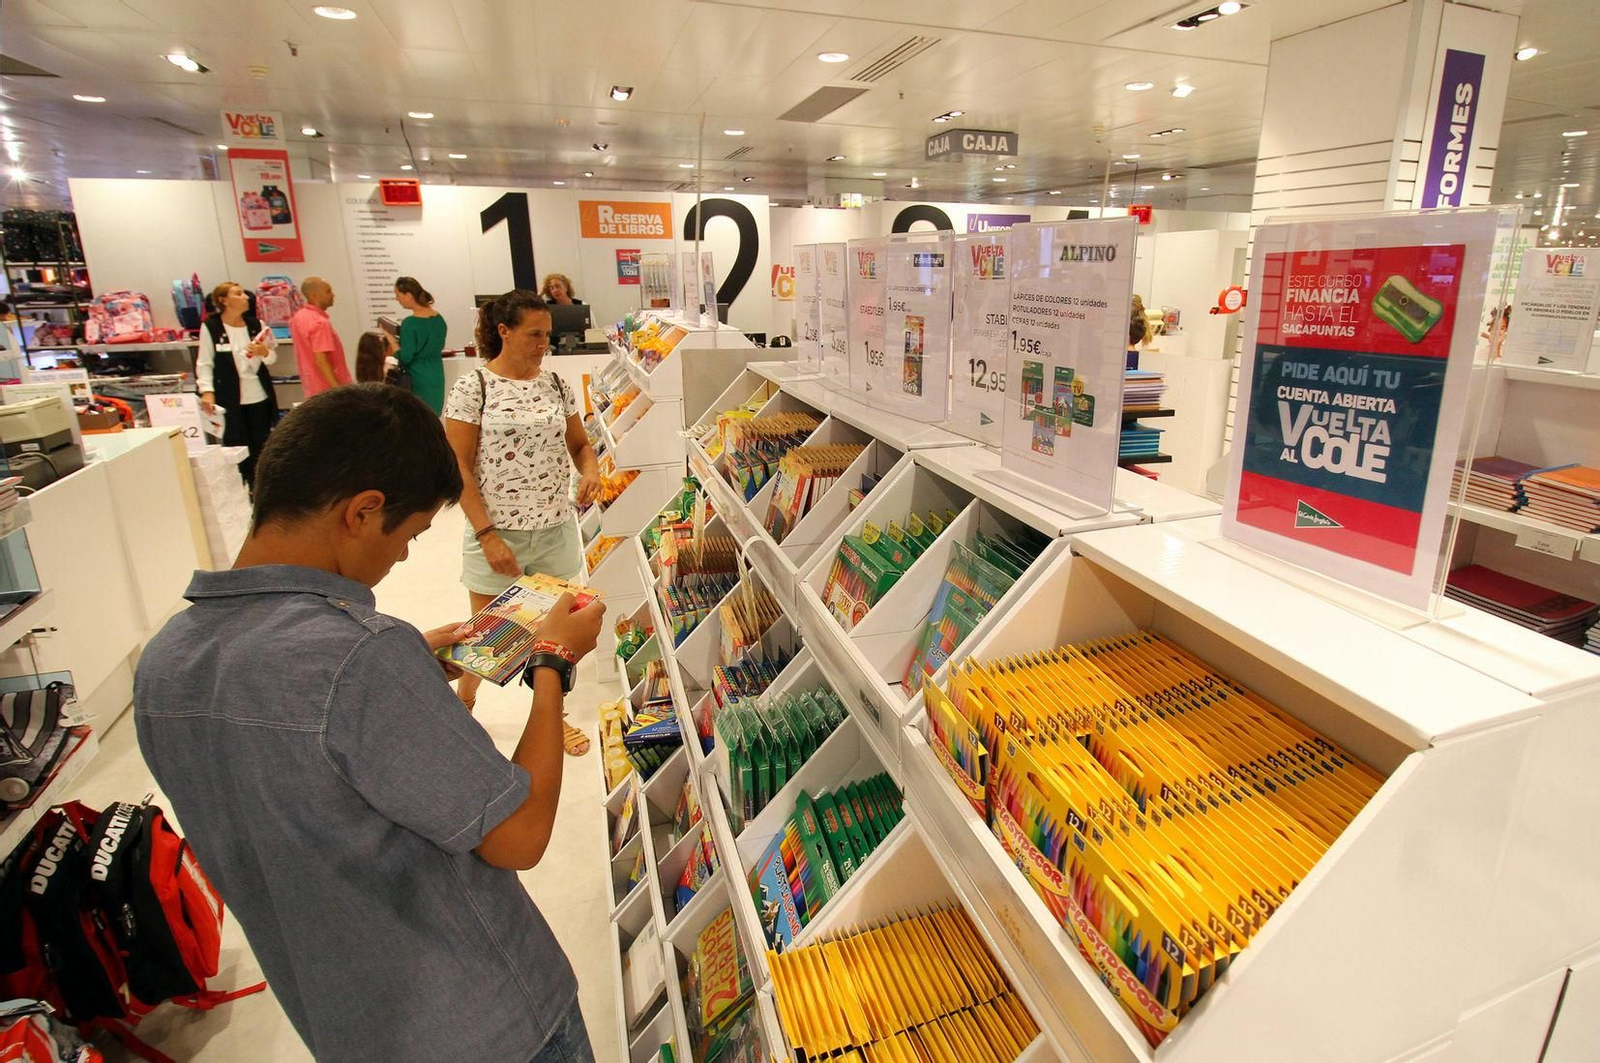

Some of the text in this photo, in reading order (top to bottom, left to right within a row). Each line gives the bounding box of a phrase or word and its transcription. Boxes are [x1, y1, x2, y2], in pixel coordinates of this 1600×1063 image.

[225, 112, 275, 129] VUELTA
[240, 121, 276, 139] COLE
[928, 133, 1009, 156] CAJA CAJA
[1436, 82, 1473, 208] FORMES
[597, 205, 663, 225] RESERVA
[600, 224, 664, 235] DE LIBROS
[480, 192, 538, 293] 1
[684, 198, 759, 309] 2
[1060, 244, 1117, 262] ALPINO
[971, 244, 1005, 268] VUELTA
[979, 254, 1005, 277] COLE
[1545, 253, 1585, 268] VUELTA
[1287, 274, 1362, 288] ESTE CURSO
[1036, 294, 1044, 302] DE
[1044, 295, 1072, 305] COLORES
[1073, 297, 1079, 305] 12
[1080, 298, 1108, 308] unidades
[1285, 288, 1360, 304] FINANCIA
[985, 313, 1008, 326] STABI
[1012, 305, 1086, 320] ROTULADORES 12 unidades
[1012, 317, 1060, 330] CERAS 12 unidades
[1283, 305, 1359, 323] HASTA EL
[1282, 323, 1356, 338] SACAPUNTAS
[969, 358, 1007, 393] 12,95
[1281, 361, 1401, 390] PIDE AQUÍ TU
[1277, 385, 1397, 414] CUENTA ABIERTA
[1277, 400, 1392, 447] VUELTA
[1280, 425, 1391, 484] AL COLE
[996, 715, 1003, 730] 12
[1011, 714, 1019, 729] 12
[969, 731, 977, 747] 12
[1069, 812, 1080, 827] 12
[1101, 802, 1112, 820] 12
[31, 819, 77, 895] DUCATI
[91, 813, 129, 882] DUCATI
[1230, 909, 1245, 933] 12
[1240, 900, 1255, 924] 12
[1211, 916, 1226, 940] 12
[716, 910, 735, 984] GRATIS
[1164, 936, 1179, 962] 12
[1181, 929, 1197, 954] 12
[1068, 902, 1164, 1024] PLASTIDECOR
[706, 976, 738, 1019] 2
